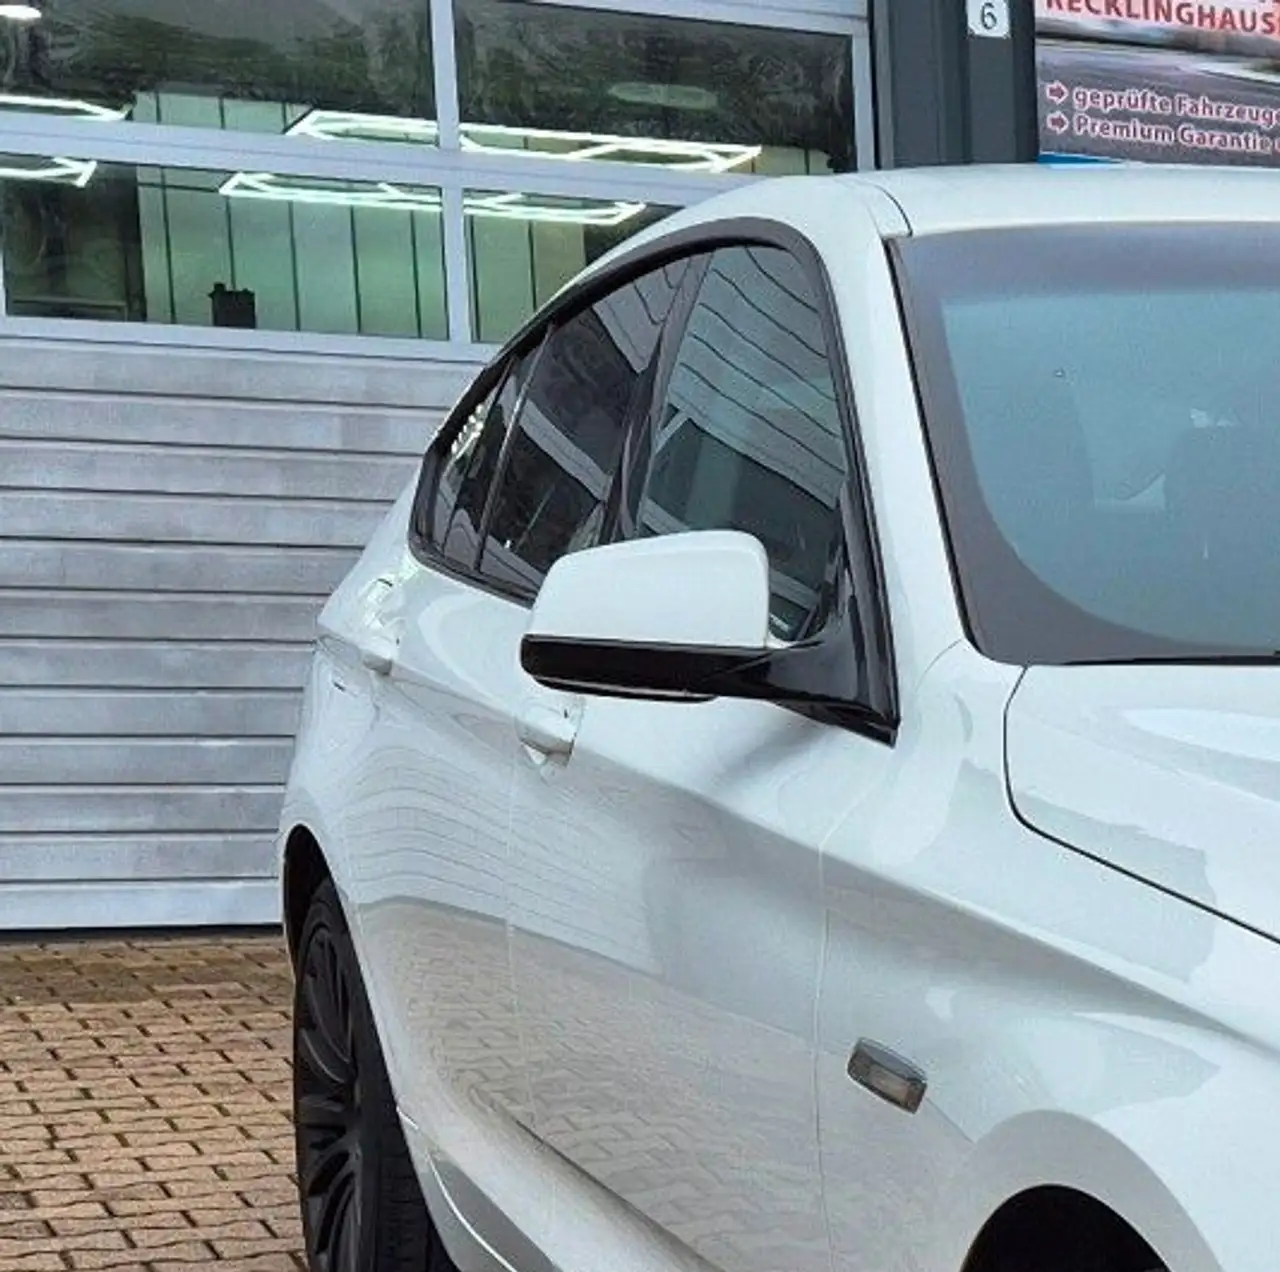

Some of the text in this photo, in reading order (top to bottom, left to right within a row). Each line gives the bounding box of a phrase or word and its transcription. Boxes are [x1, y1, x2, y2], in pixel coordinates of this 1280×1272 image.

[981, 3, 997, 30] 6
[1074, 88, 1172, 113] geprüfte
[1075, 114, 1273, 151] Premium Garantie
